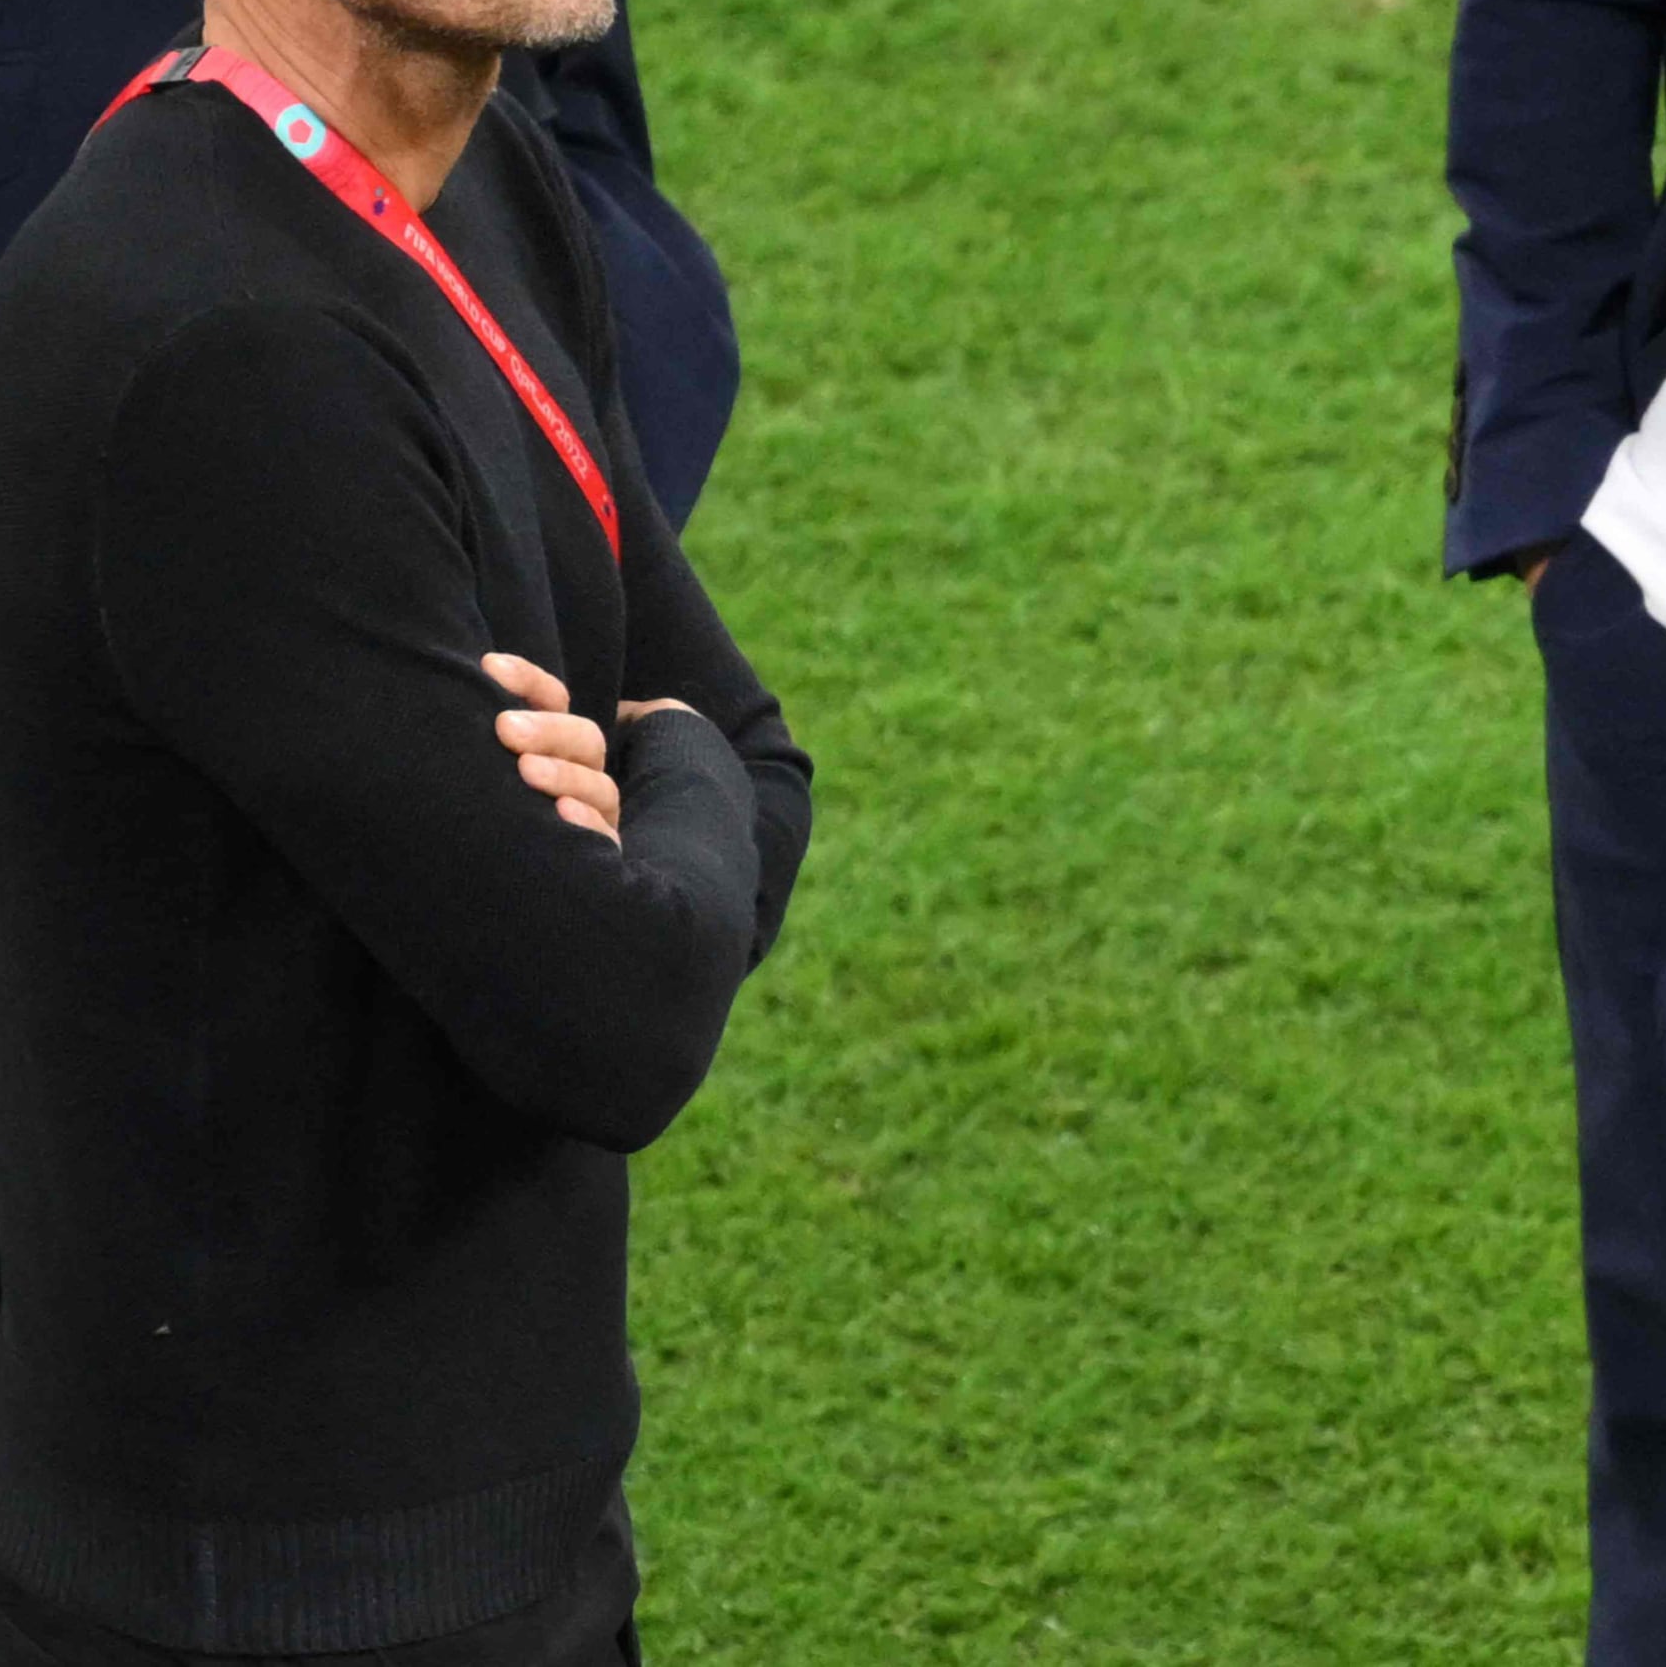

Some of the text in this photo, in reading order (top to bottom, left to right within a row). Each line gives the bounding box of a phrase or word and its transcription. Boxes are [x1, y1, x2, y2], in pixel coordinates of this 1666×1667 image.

[404, 222, 436, 266] FIFA
[435, 255, 481, 323] WORLD
[480, 317, 507, 354] CUP
